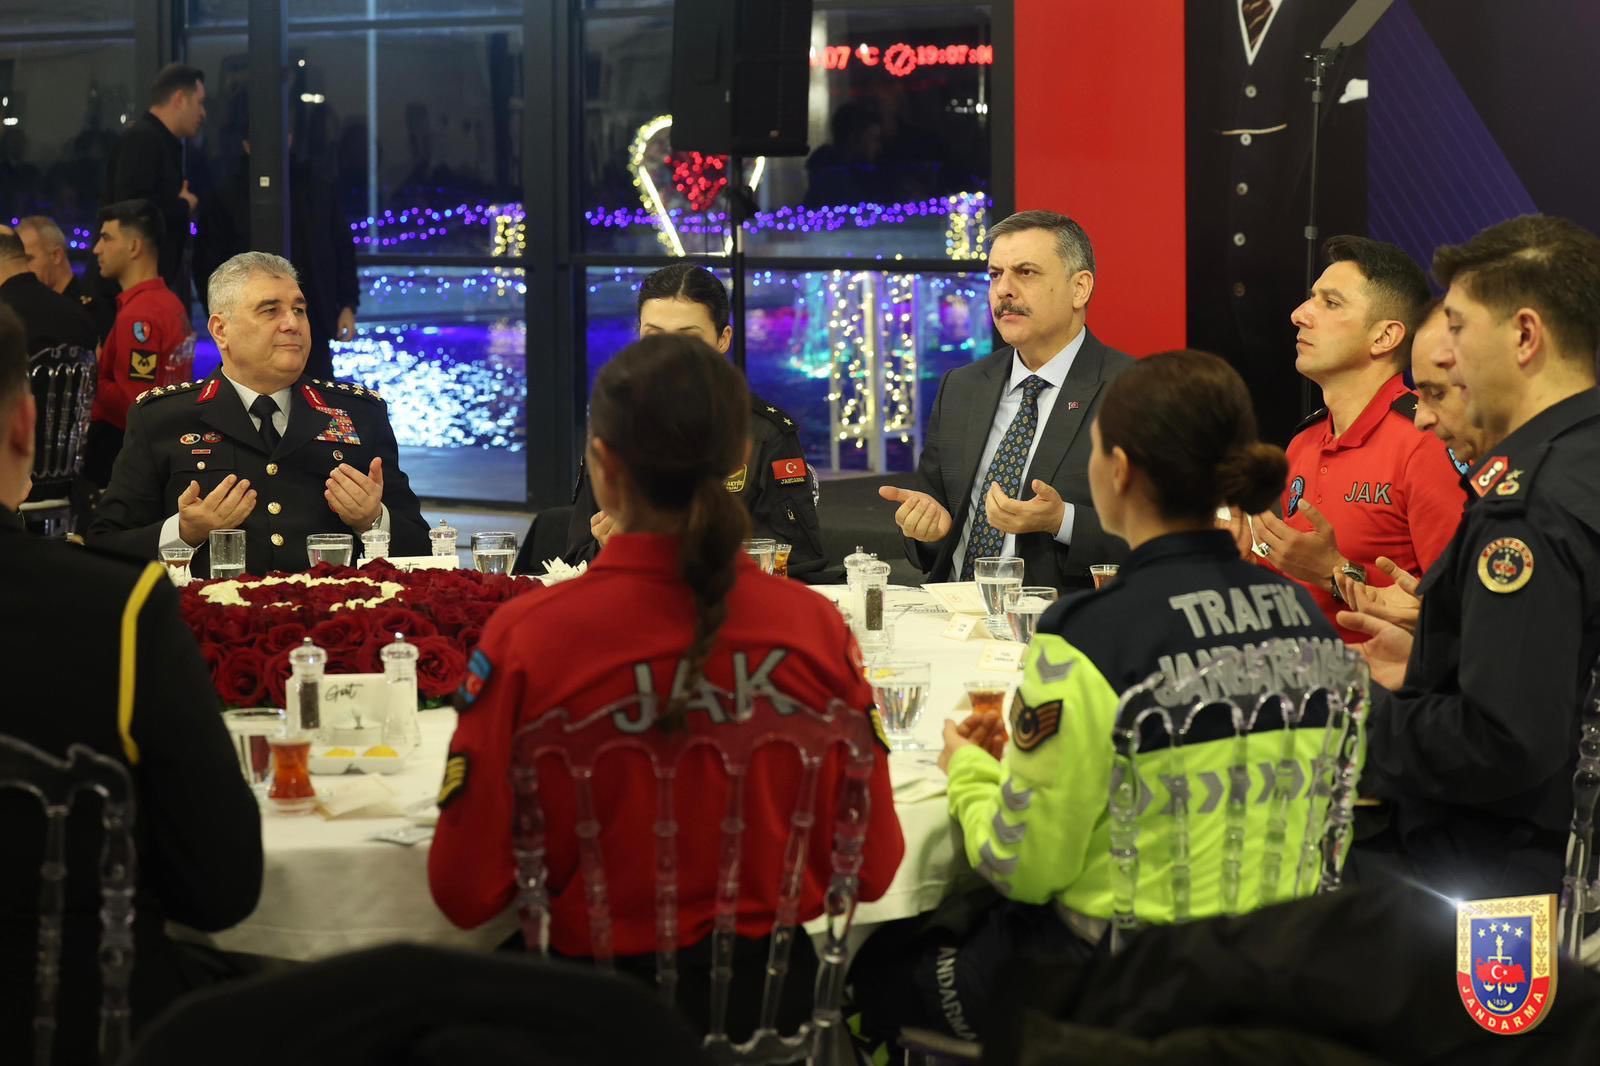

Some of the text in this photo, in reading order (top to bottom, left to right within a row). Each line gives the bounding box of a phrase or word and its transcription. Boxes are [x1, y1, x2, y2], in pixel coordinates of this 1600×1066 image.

[1344, 481, 1393, 505] JAK
[1168, 583, 1311, 638] TRAFİK
[611, 648, 801, 733] JAK
